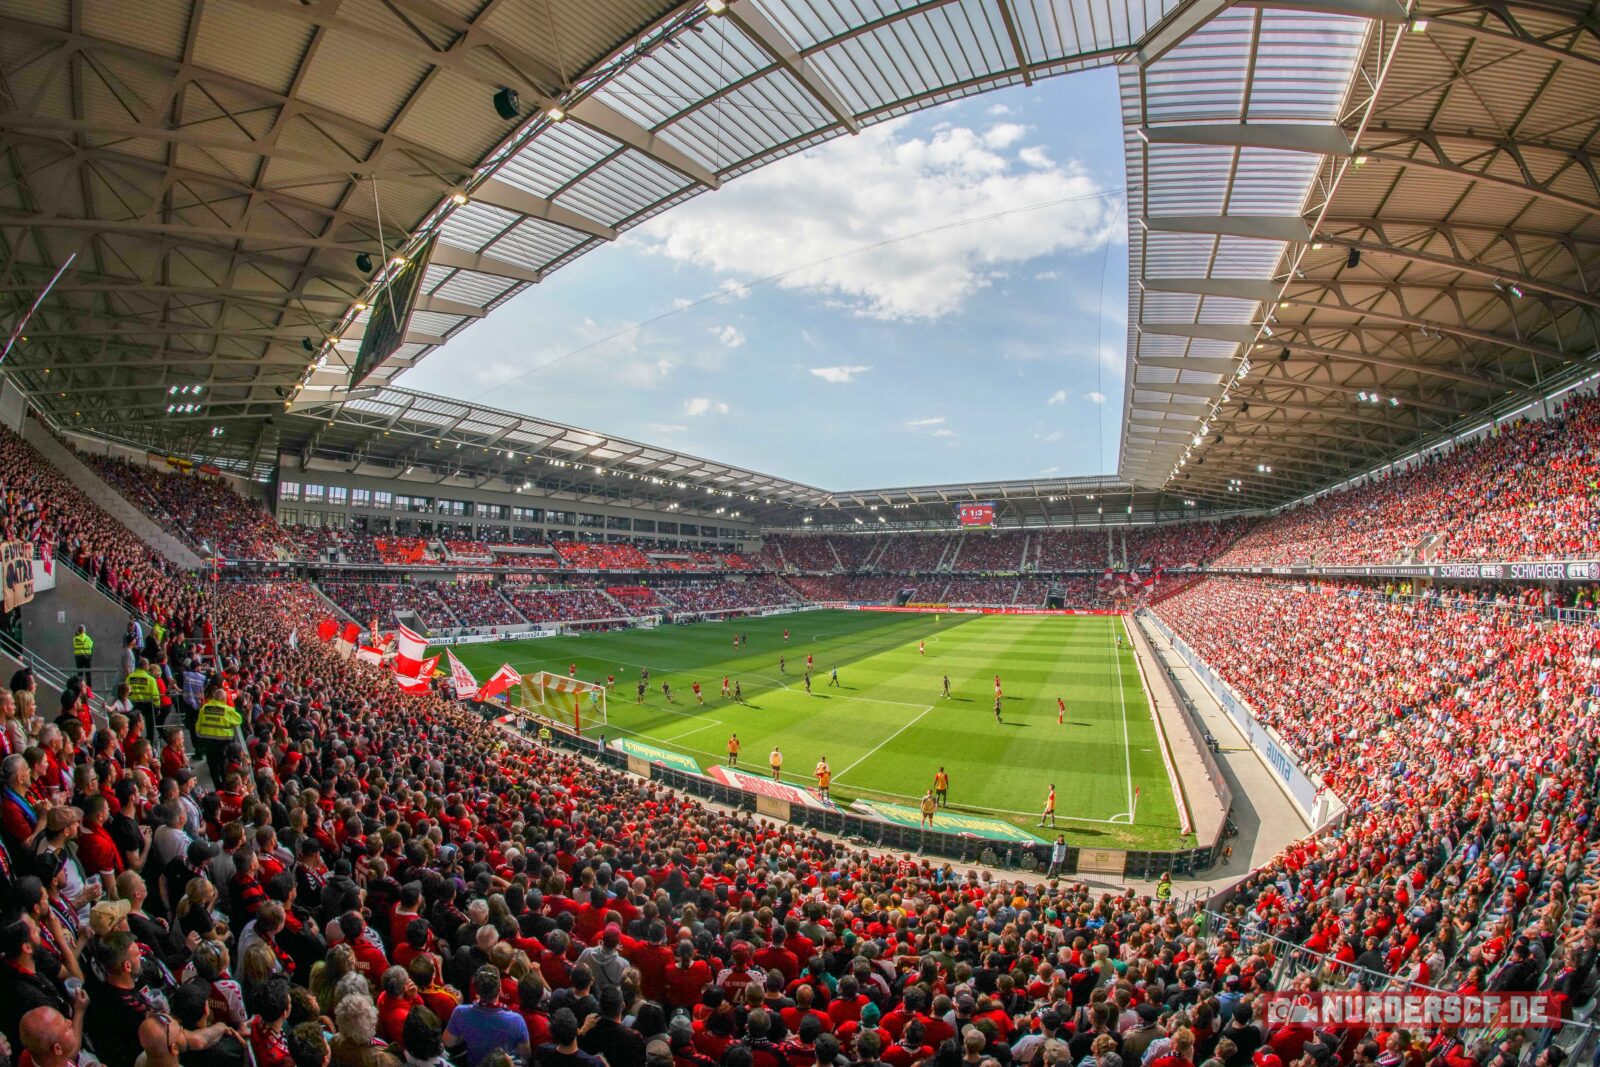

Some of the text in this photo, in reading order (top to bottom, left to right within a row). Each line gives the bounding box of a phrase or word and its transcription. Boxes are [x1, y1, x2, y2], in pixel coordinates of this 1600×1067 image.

[1440, 565, 1479, 578] SCHWEIGER
[1511, 564, 1565, 579] SCHWEIGER
[429, 637, 468, 645] oelluxx2.de
[1266, 740, 1292, 782] auma
